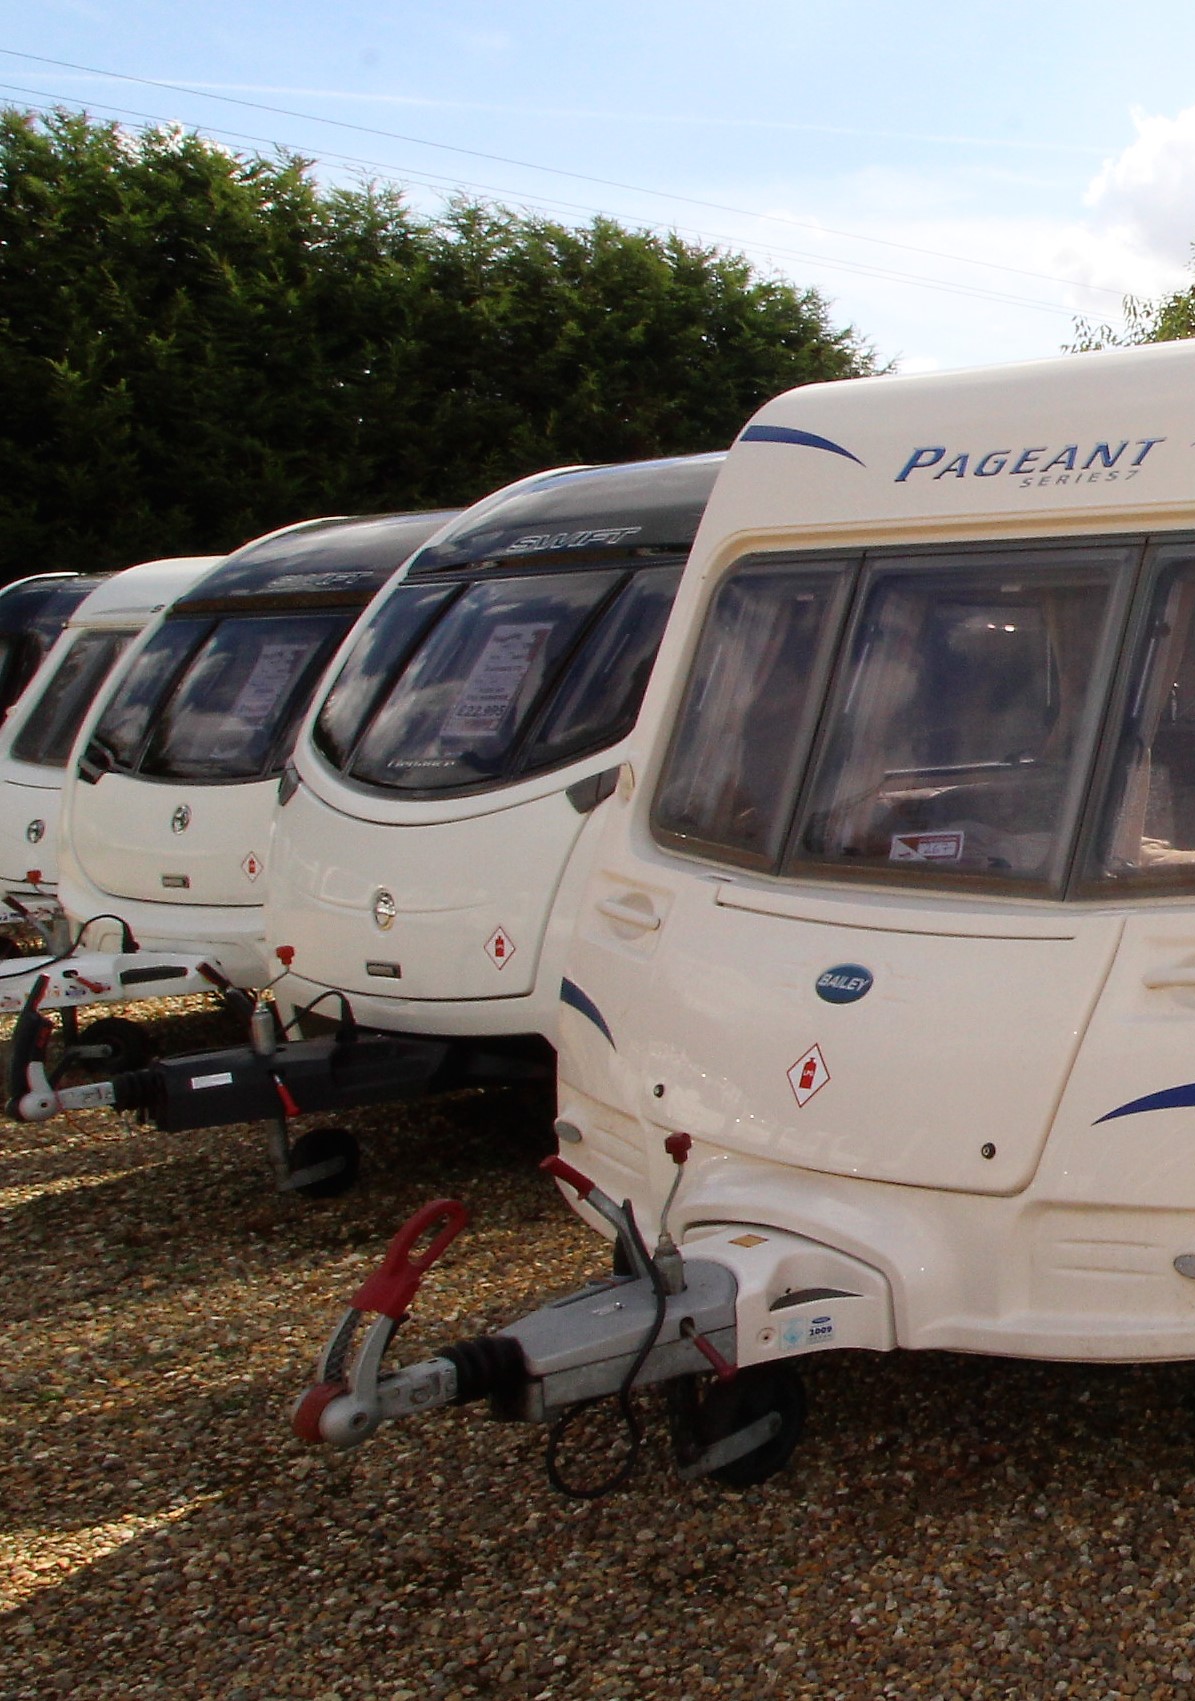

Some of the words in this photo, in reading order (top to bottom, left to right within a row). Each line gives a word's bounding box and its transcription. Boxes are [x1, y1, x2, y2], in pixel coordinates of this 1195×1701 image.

[894, 436, 1167, 482] PAGEANT
[505, 525, 643, 553] SWIFT
[818, 973, 869, 991] BAILEY
